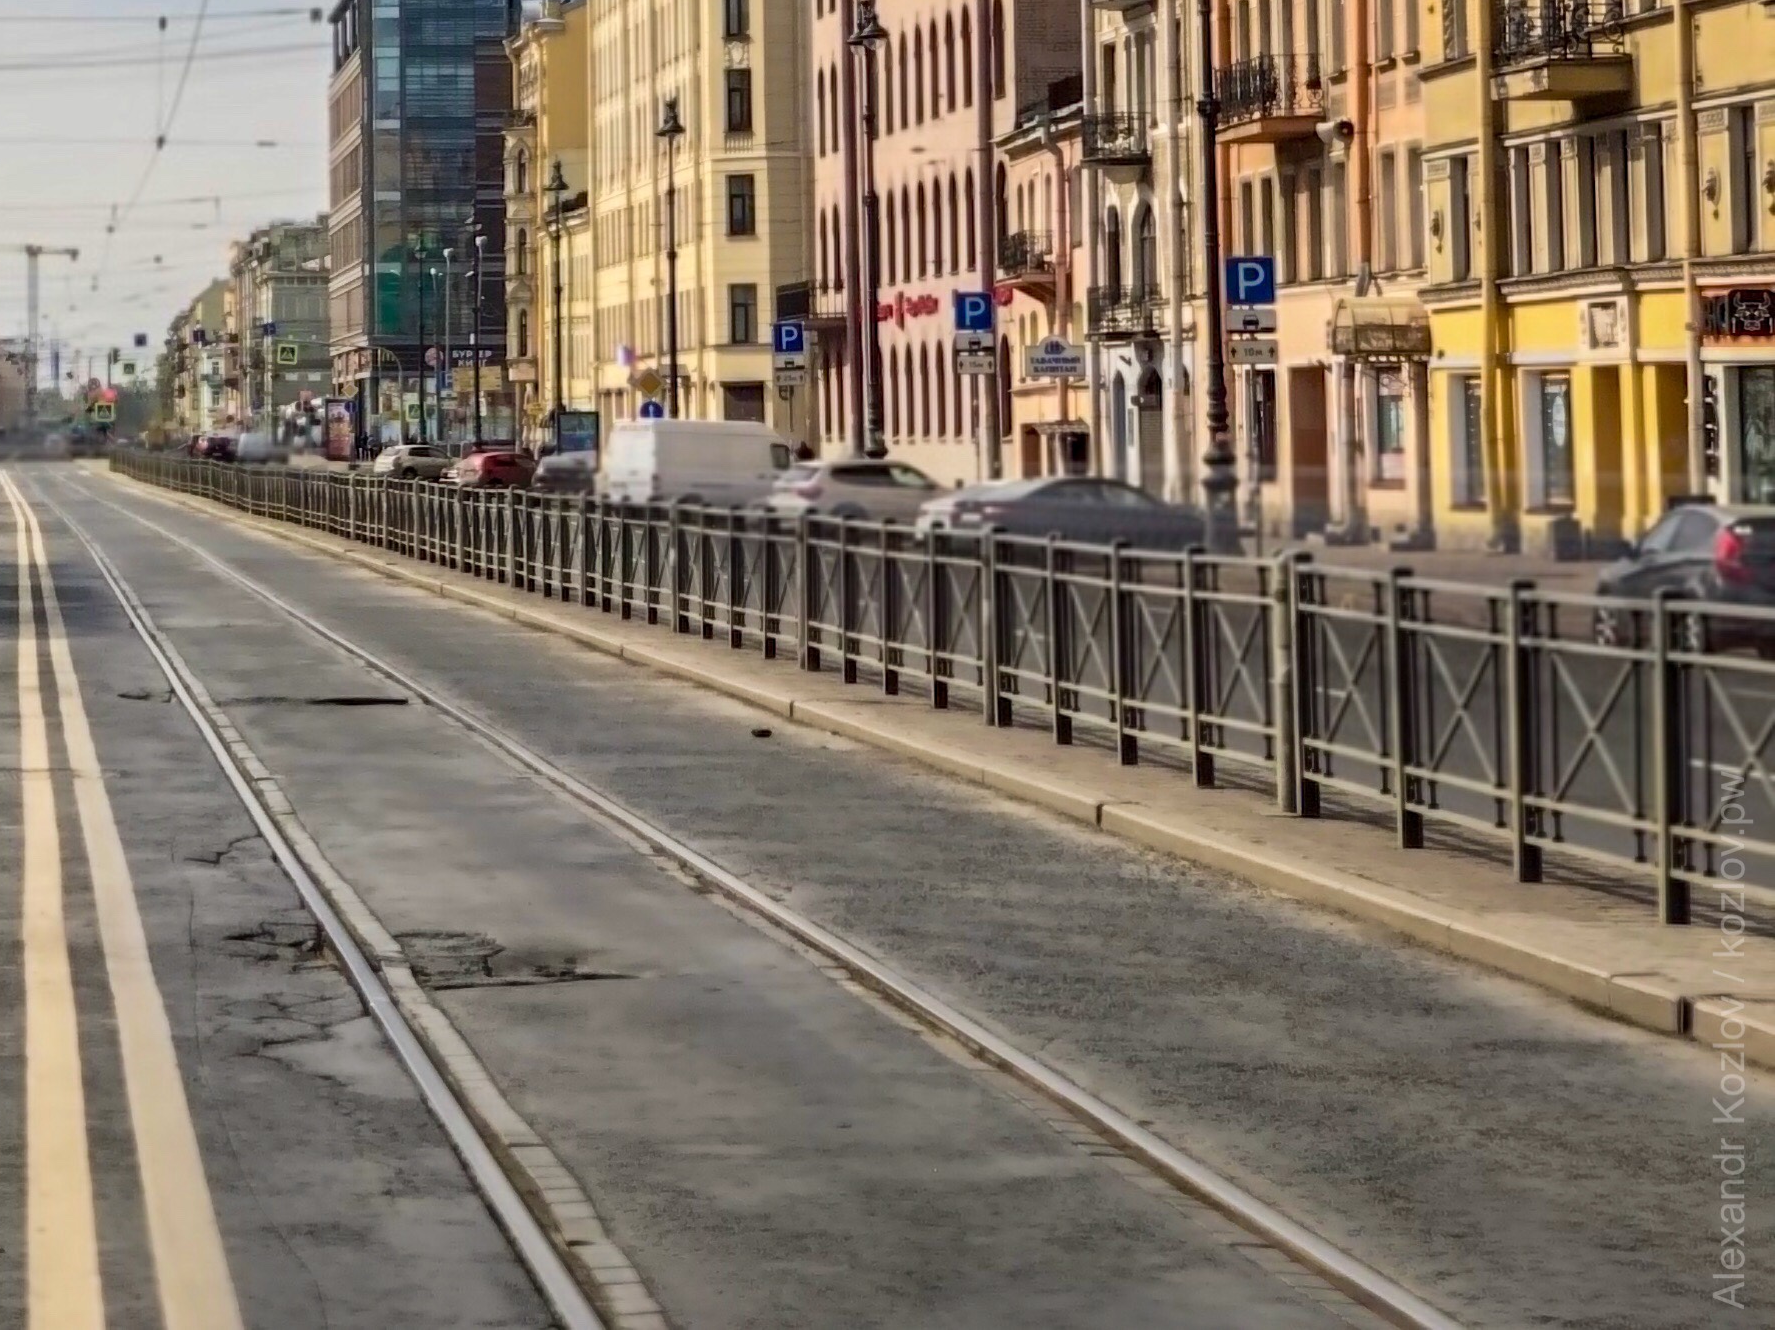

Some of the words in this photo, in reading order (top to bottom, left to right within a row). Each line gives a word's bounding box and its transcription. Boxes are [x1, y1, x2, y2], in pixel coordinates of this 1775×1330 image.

[1238, 262, 1265, 300] P
[965, 297, 986, 326] P
[781, 326, 798, 350] P
[452, 350, 493, 358] БУРЕР
[1033, 365, 1077, 373] КАПИТАН
